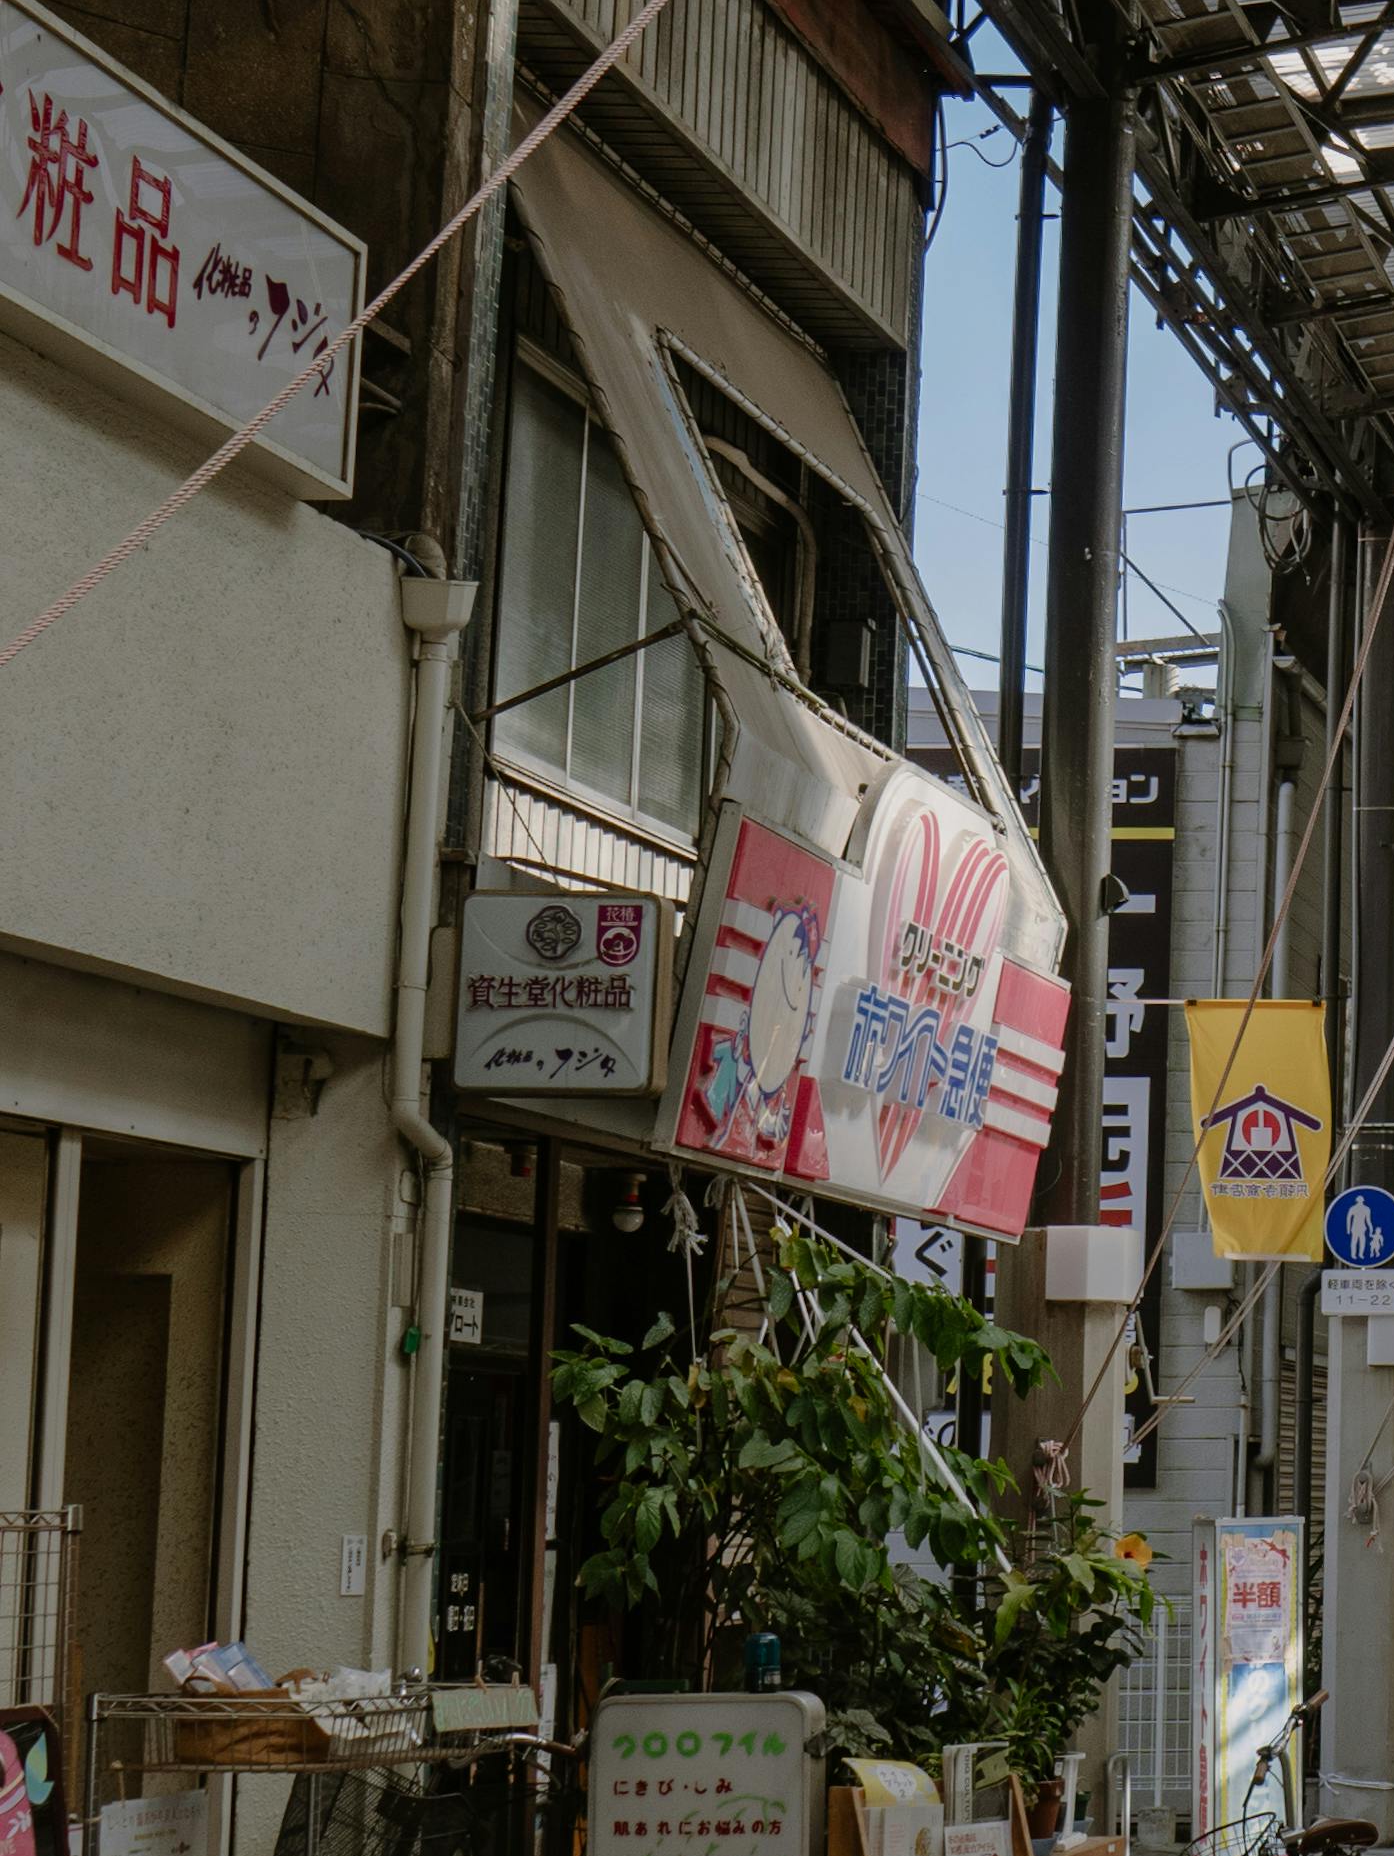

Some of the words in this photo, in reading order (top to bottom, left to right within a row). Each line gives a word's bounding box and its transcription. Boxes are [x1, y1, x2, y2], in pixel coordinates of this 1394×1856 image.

[0, 87, 181, 330] 粧品
[900, 921, 985, 998] クリーニング
[466, 974, 632, 1009] 資生堂化粧品
[842, 983, 998, 1129] ホワイト急便
[1231, 1581, 1282, 1609] 半額
[612, 1819, 784, 1837] 肌あれにお悩みの方
